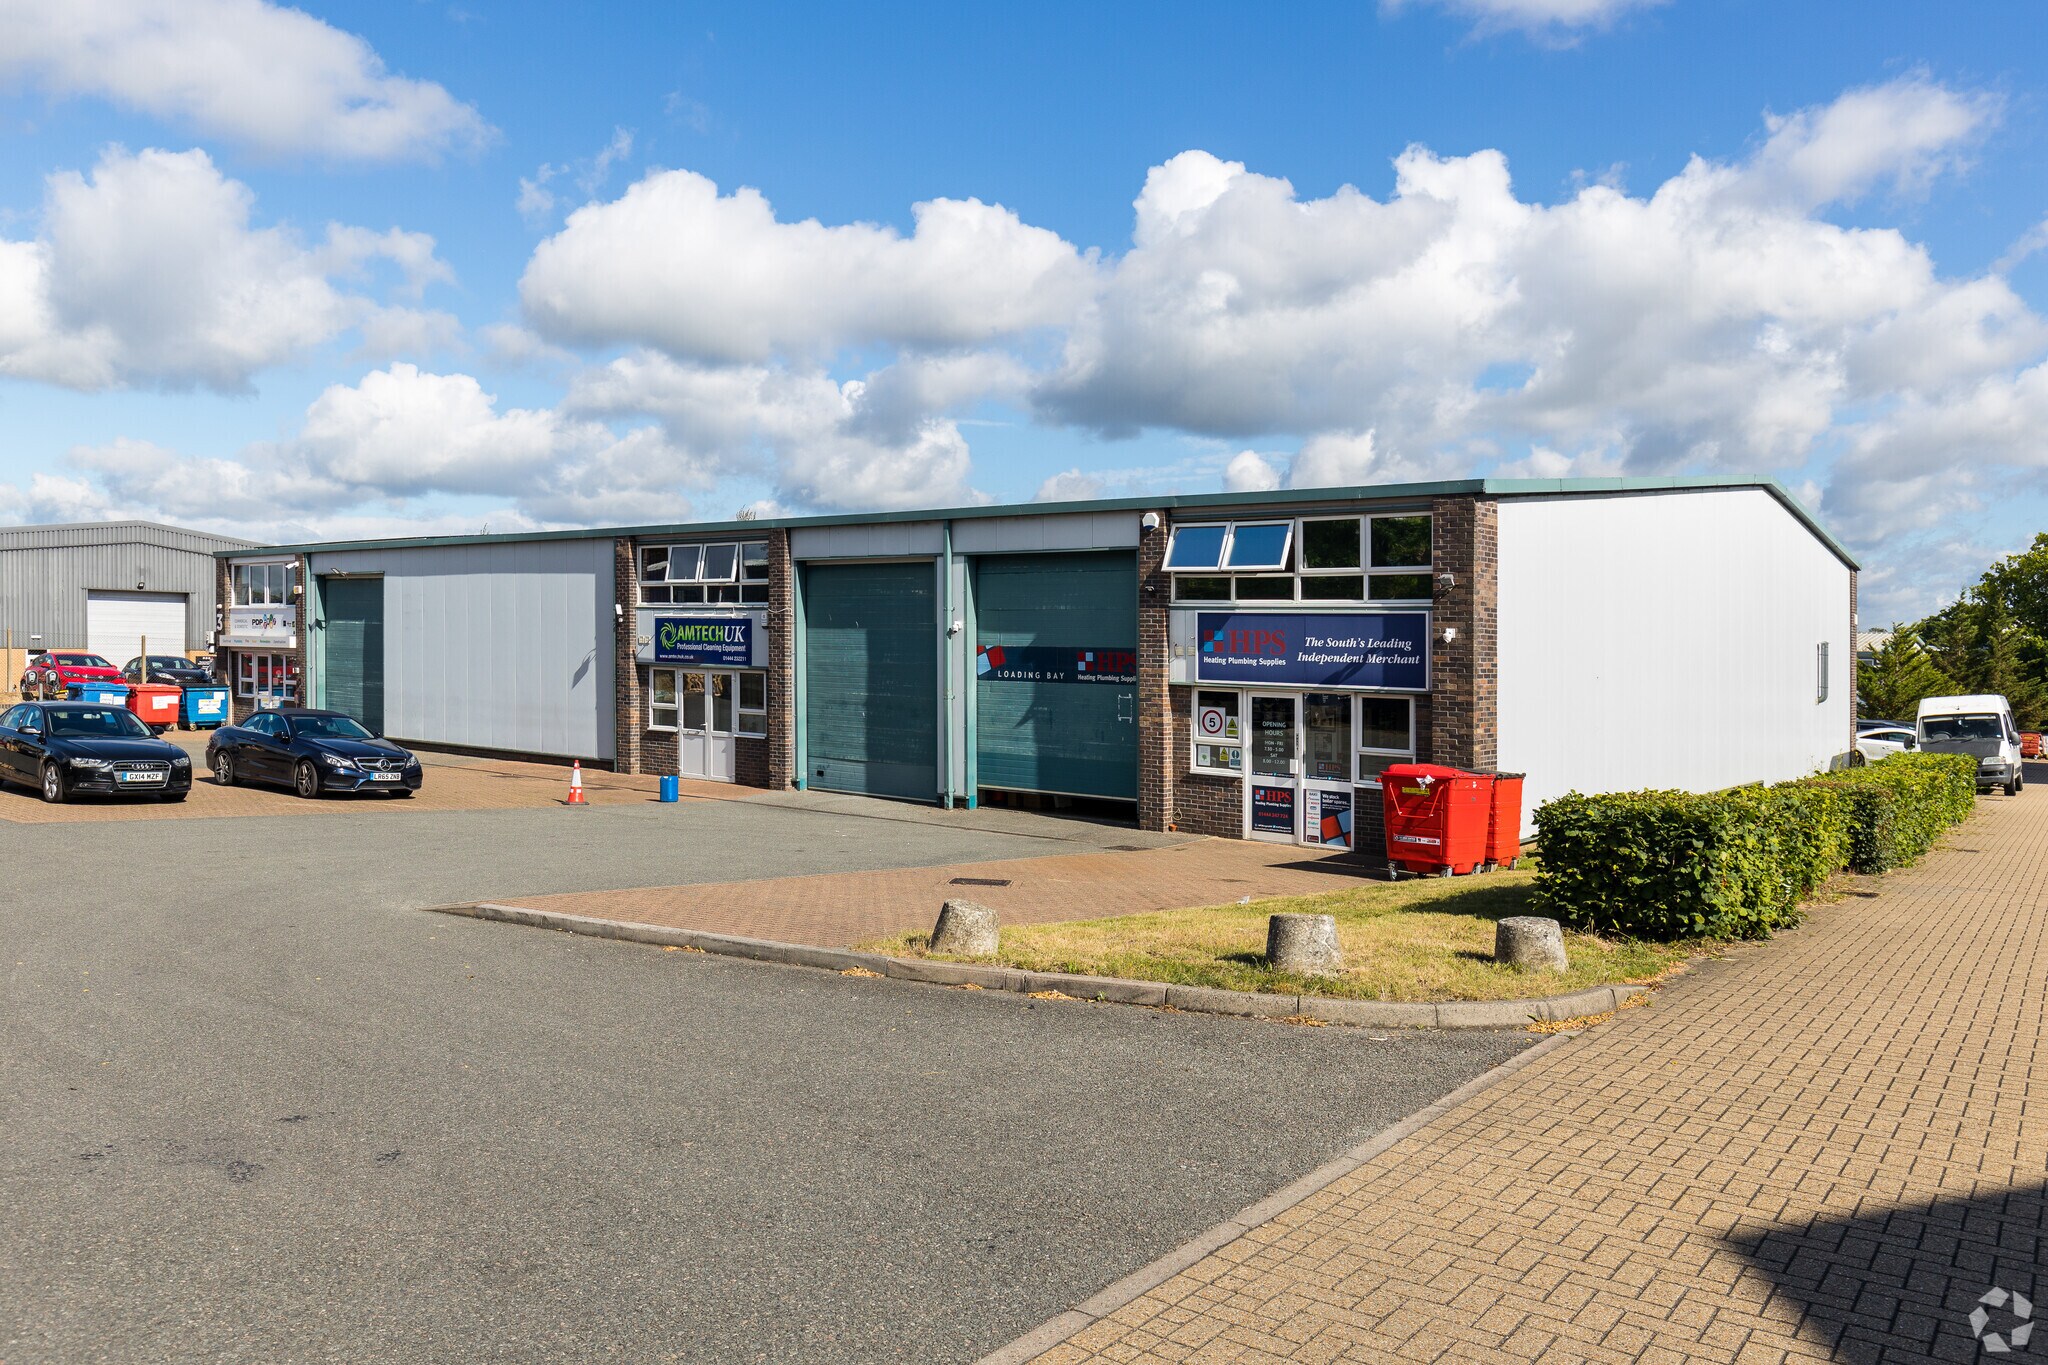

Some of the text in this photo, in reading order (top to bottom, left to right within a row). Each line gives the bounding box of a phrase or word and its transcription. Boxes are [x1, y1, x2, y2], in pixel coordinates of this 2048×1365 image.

[216, 614, 223, 630] 3
[703, 644, 722, 652] Cleaning
[723, 644, 746, 652] Equipment
[1229, 630, 1286, 655] HPS
[1305, 637, 1412, 651] The South's Leading
[1203, 656, 1286, 666] Heating Plumbing Supplies
[1297, 652, 1420, 664] Independent Merchant
[998, 671, 1040, 679] LOADING
[1209, 718, 1216, 727] 5
[1266, 790, 1292, 803] HPS
